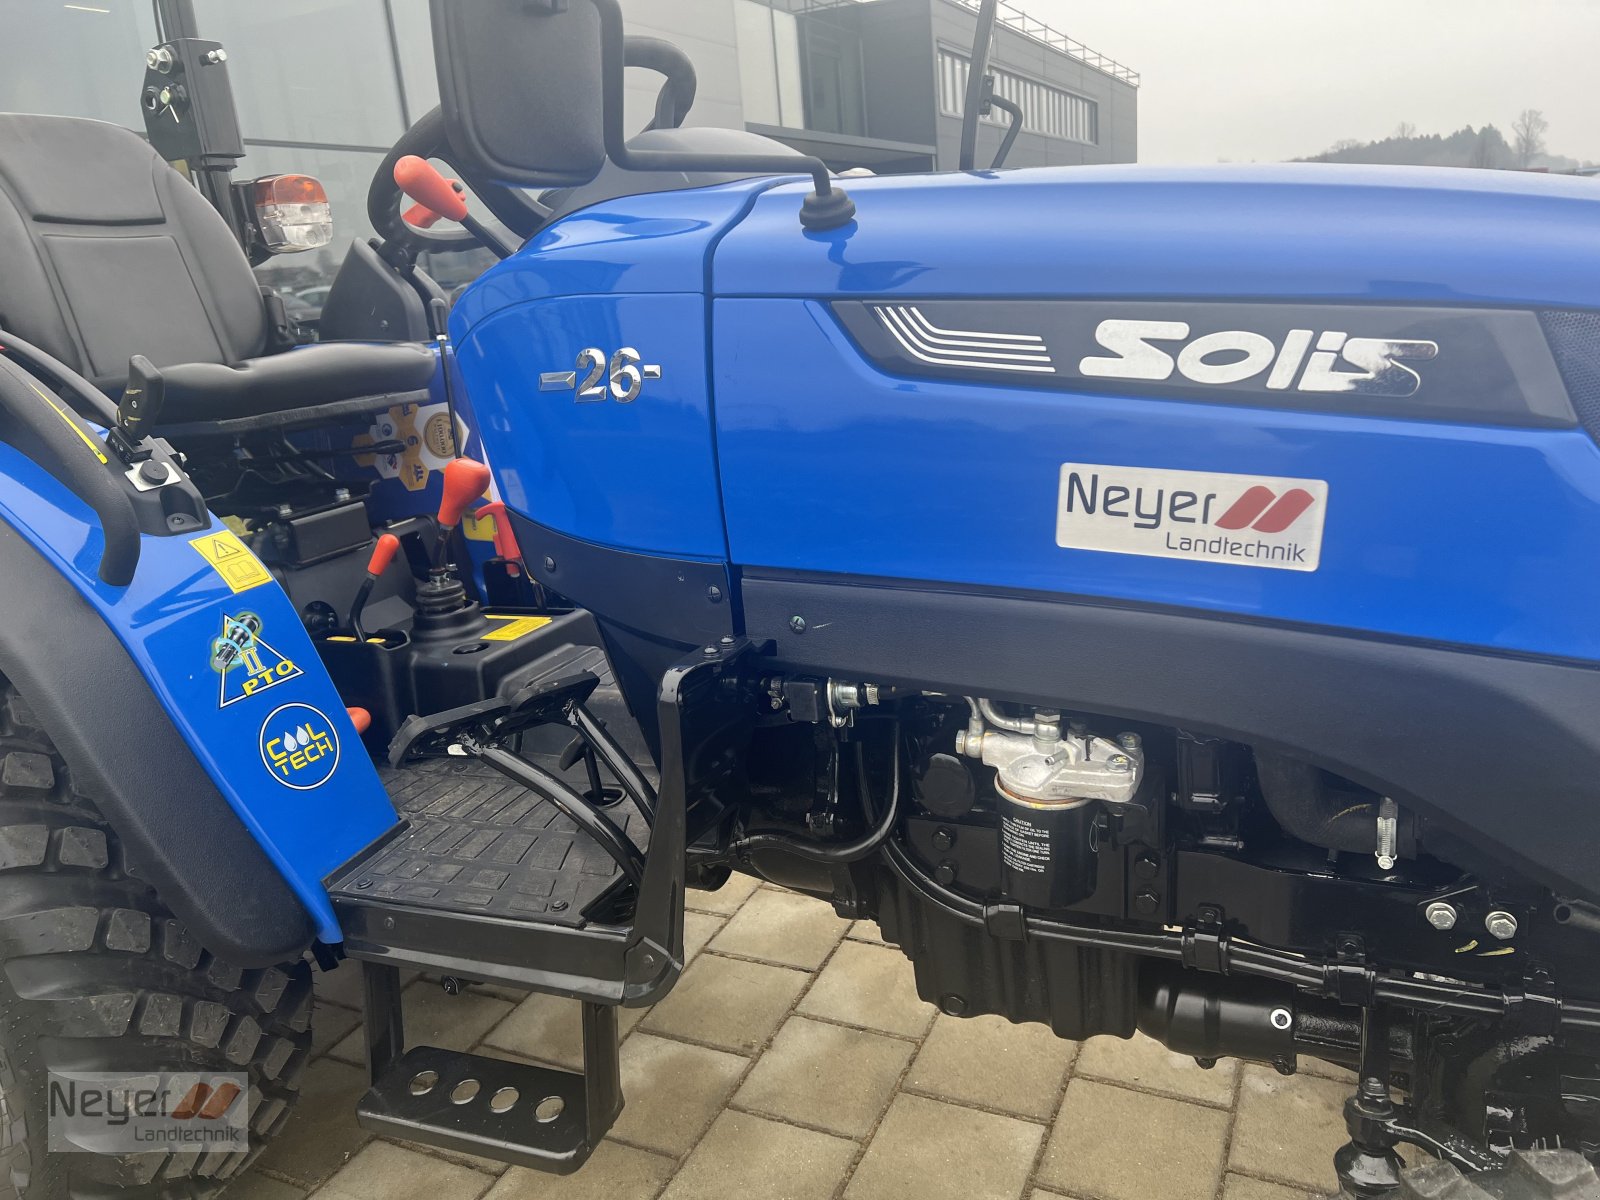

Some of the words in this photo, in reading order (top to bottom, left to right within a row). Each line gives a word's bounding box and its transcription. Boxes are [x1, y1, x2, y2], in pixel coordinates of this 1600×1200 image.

[1066, 472, 1216, 529] Neyer
[1166, 532, 1306, 562] Landtechnik
[242, 660, 294, 696] PTO
[274, 737, 334, 775] TECH
[1013, 817, 1031, 827] CAUTION
